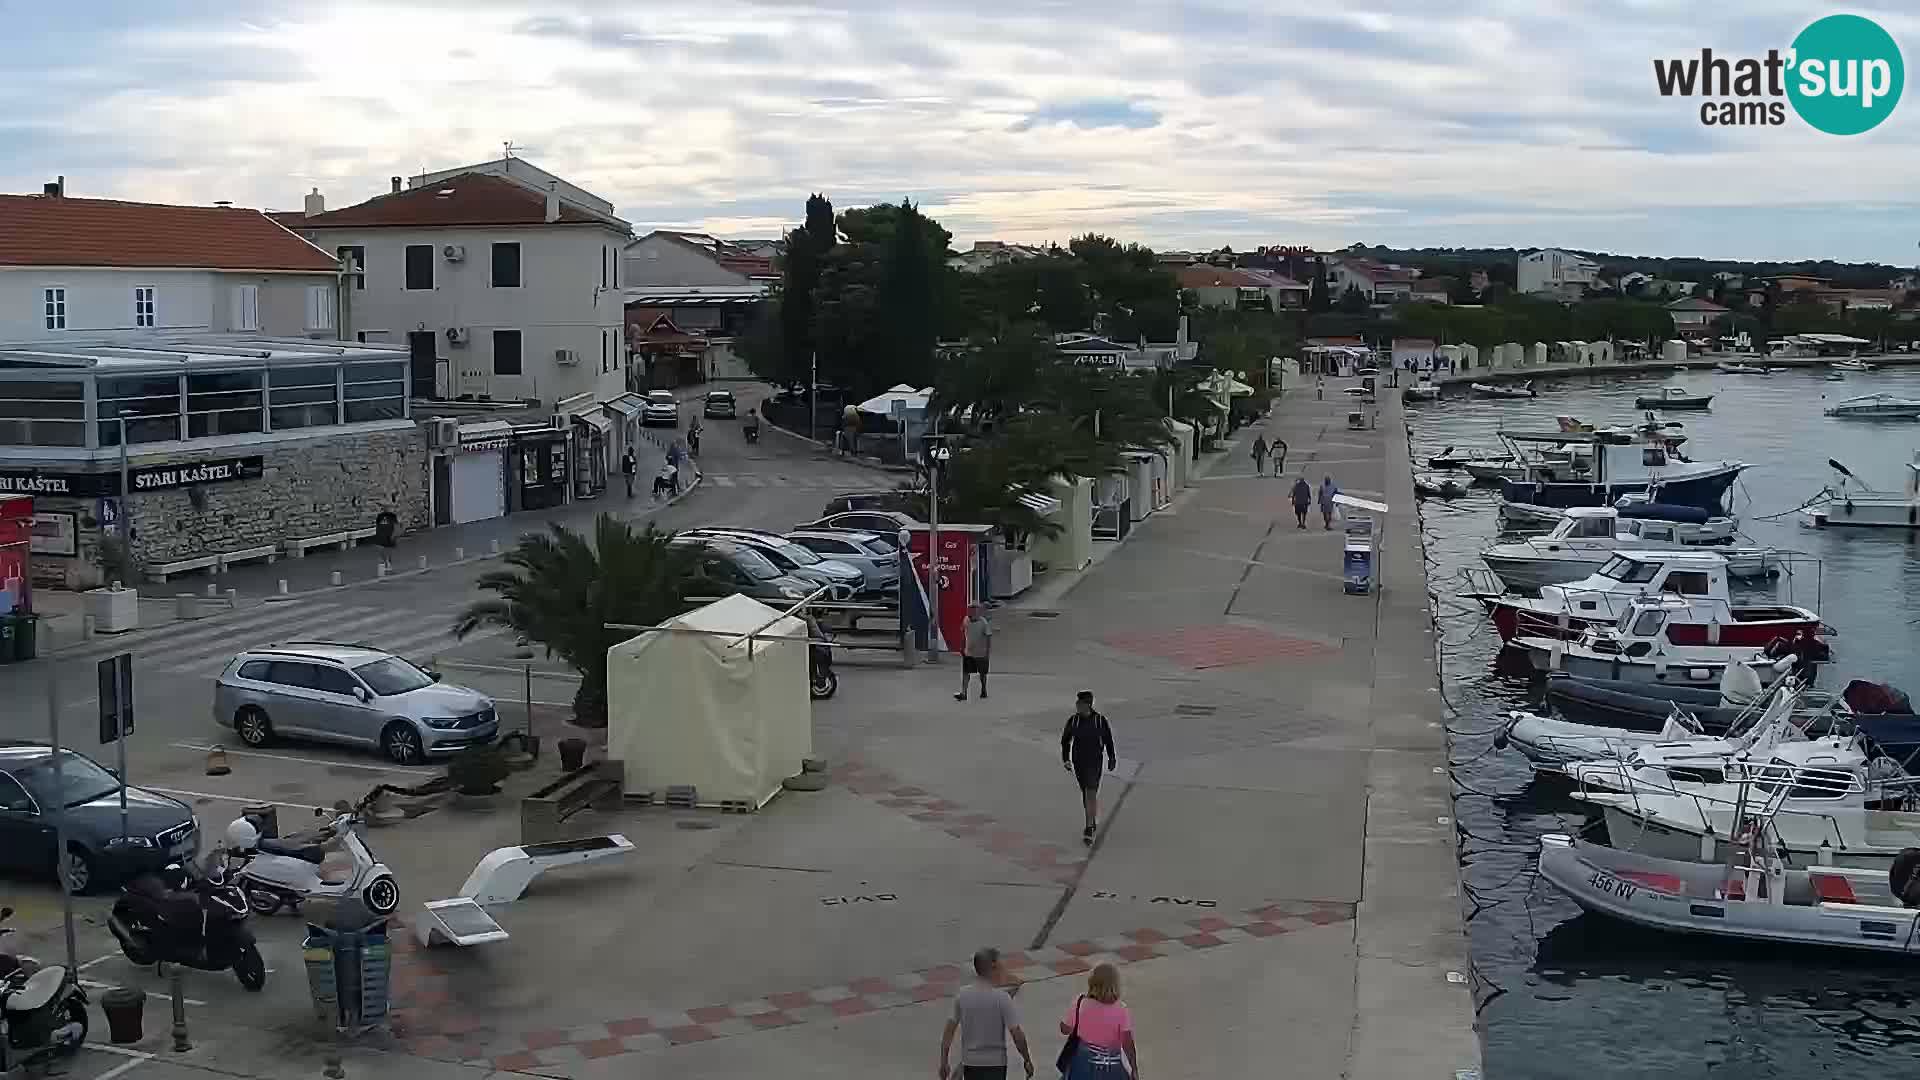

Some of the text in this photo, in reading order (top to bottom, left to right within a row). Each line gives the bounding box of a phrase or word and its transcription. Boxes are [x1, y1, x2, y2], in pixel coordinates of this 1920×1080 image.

[15, 475, 69, 493] KAŠTEL
[135, 463, 232, 489] STARI KAŠTEL
[1586, 872, 1615, 893] 456
